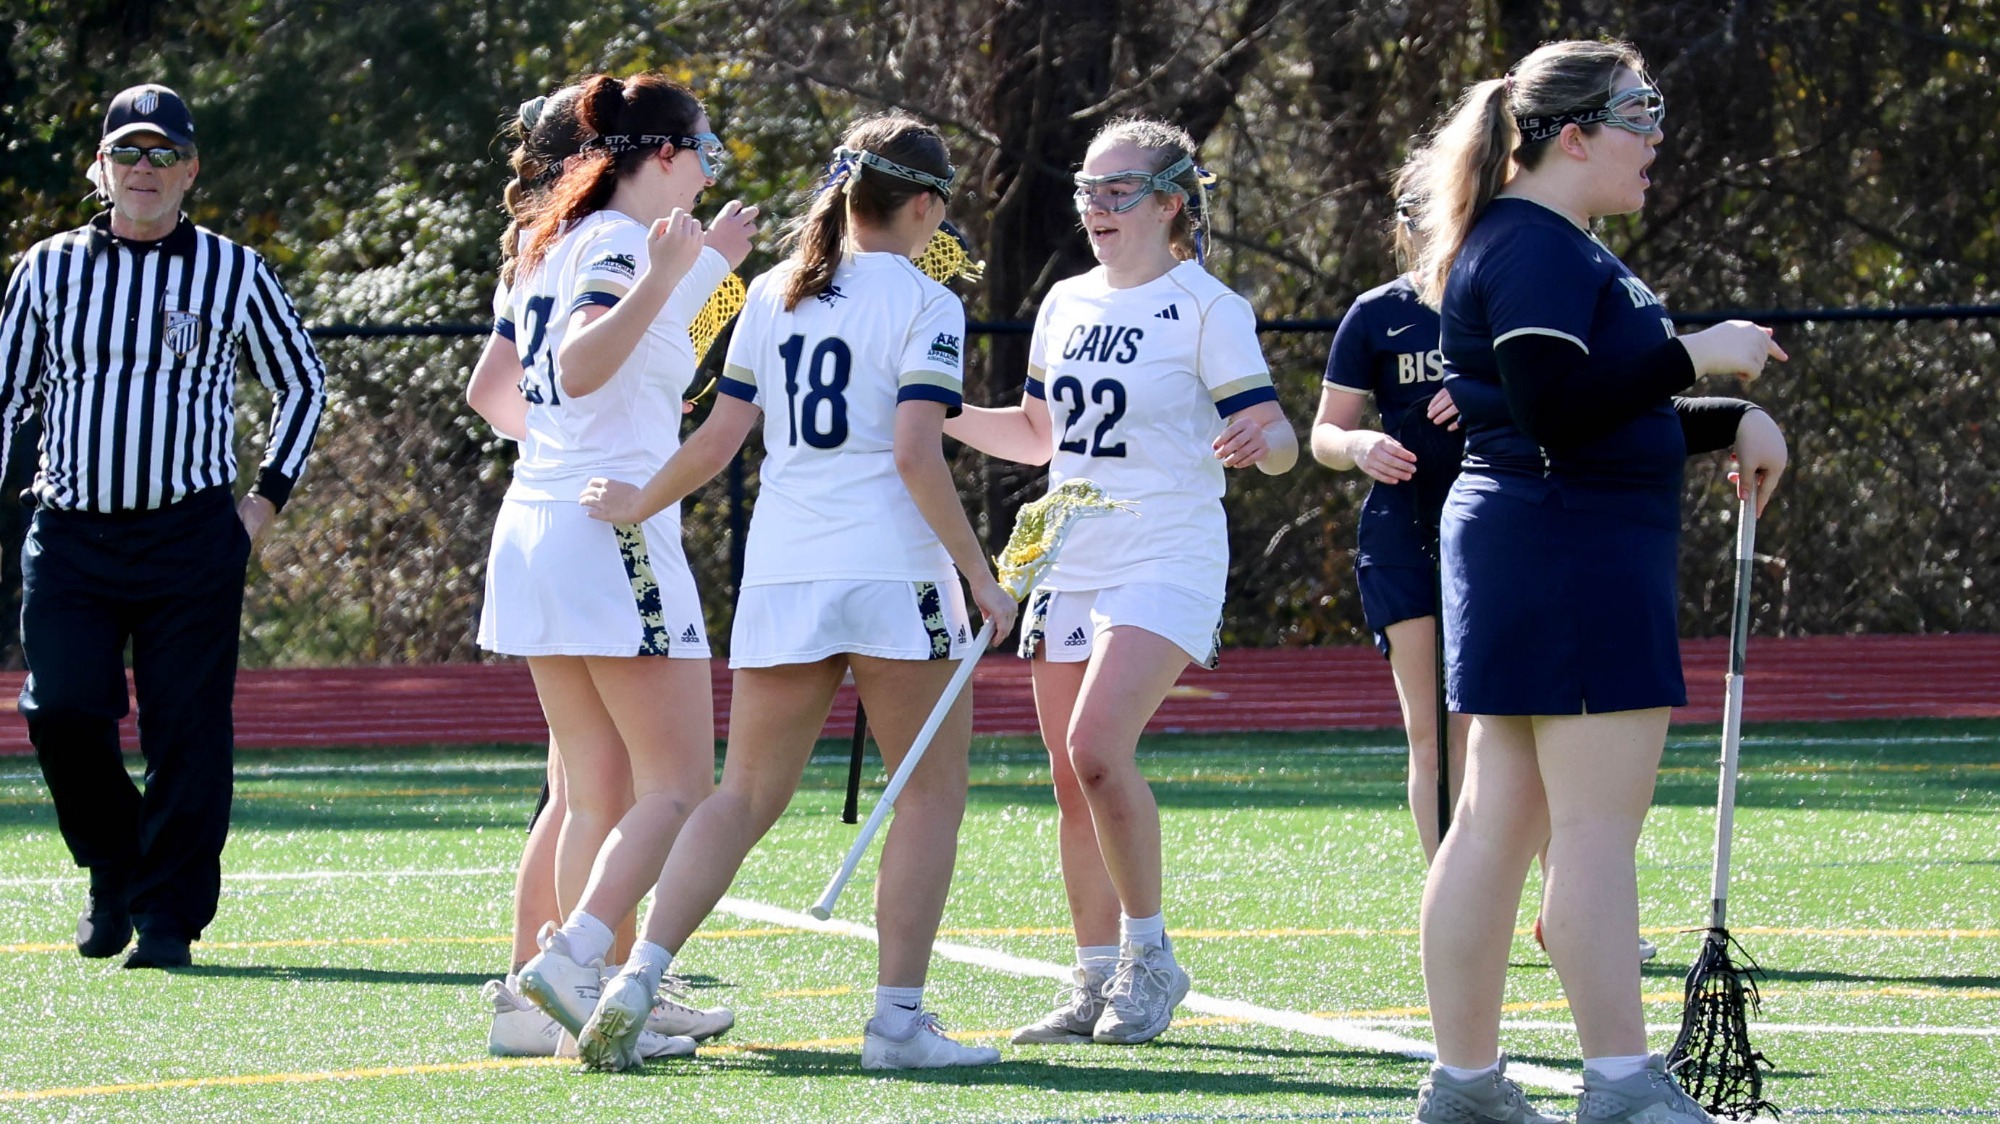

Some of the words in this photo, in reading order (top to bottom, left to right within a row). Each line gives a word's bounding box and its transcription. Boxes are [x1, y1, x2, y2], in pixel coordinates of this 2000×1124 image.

[605, 134, 630, 145] STX
[640, 134, 672, 144] STX
[1063, 324, 1144, 365] CAVS
[778, 332, 852, 449] 18
[1052, 375, 1127, 458] 22
